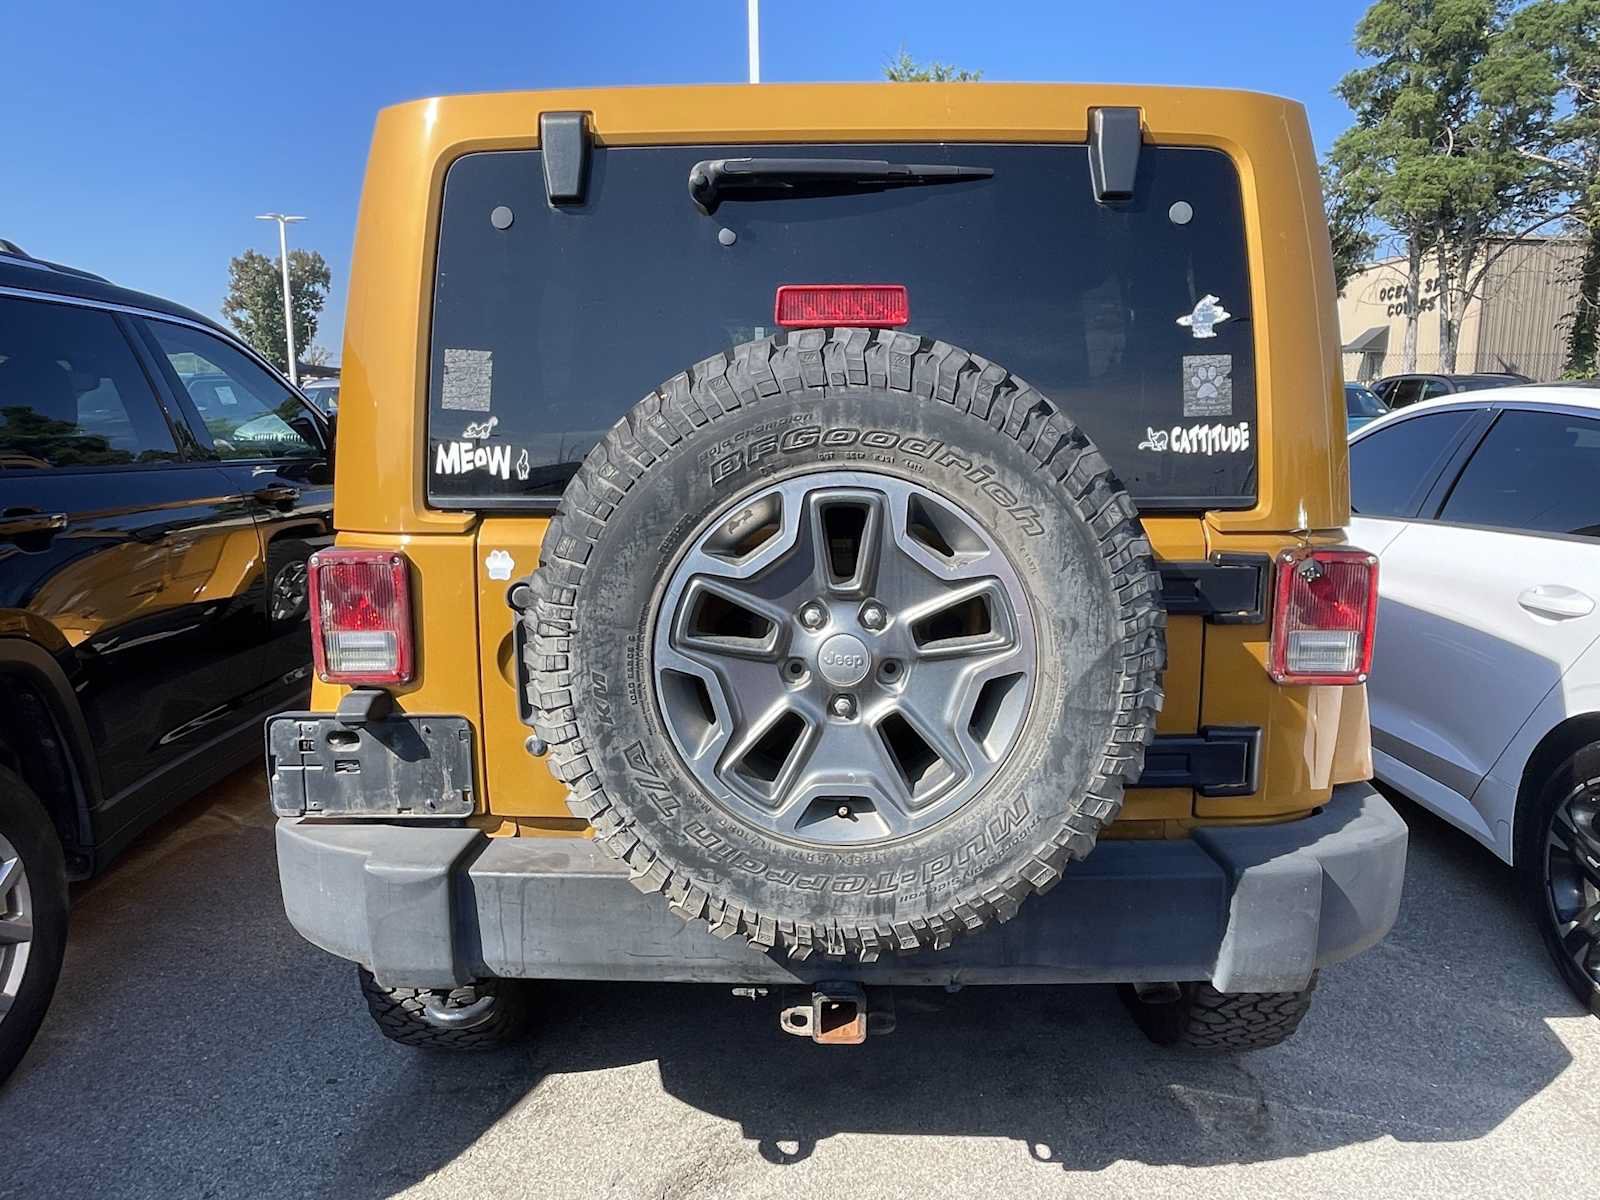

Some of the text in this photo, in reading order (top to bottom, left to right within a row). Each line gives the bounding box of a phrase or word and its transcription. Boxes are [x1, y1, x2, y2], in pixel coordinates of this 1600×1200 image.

[1380, 284, 1409, 301] OCEA
[1387, 297, 1435, 317] CORS
[1170, 422, 1250, 457] CATTITUDE
[435, 441, 512, 480] MEOW
[710, 425, 1045, 536] BFGoodrich
[824, 651, 864, 669] Jeep
[591, 671, 616, 725] KM
[624, 740, 682, 818] T/A
[683, 791, 1030, 896] Mud-Terrain
